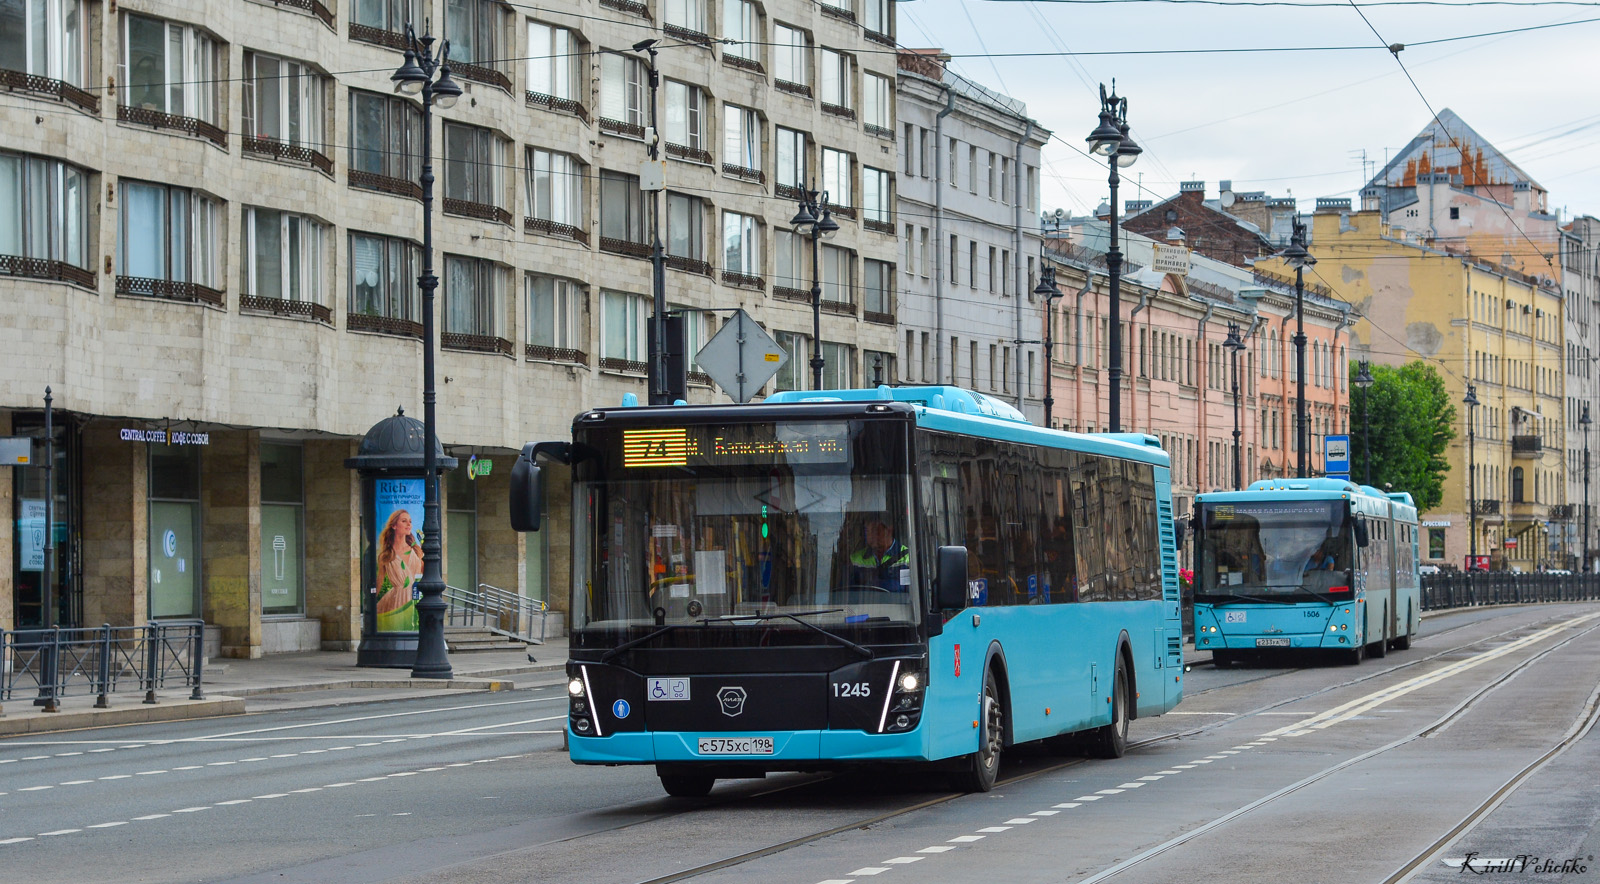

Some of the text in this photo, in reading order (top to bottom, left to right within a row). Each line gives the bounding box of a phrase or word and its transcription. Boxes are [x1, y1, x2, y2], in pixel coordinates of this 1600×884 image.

[120, 428, 166, 443] CENTRAL COFFEE
[191, 431, 209, 445] СОБОЙ
[687, 438, 703, 456] М.
[715, 437, 808, 455] Балканская
[380, 481, 407, 493] Rich
[1303, 610, 1320, 618] 1506
[832, 682, 871, 697] 1245
[752, 739, 770, 749] 198
